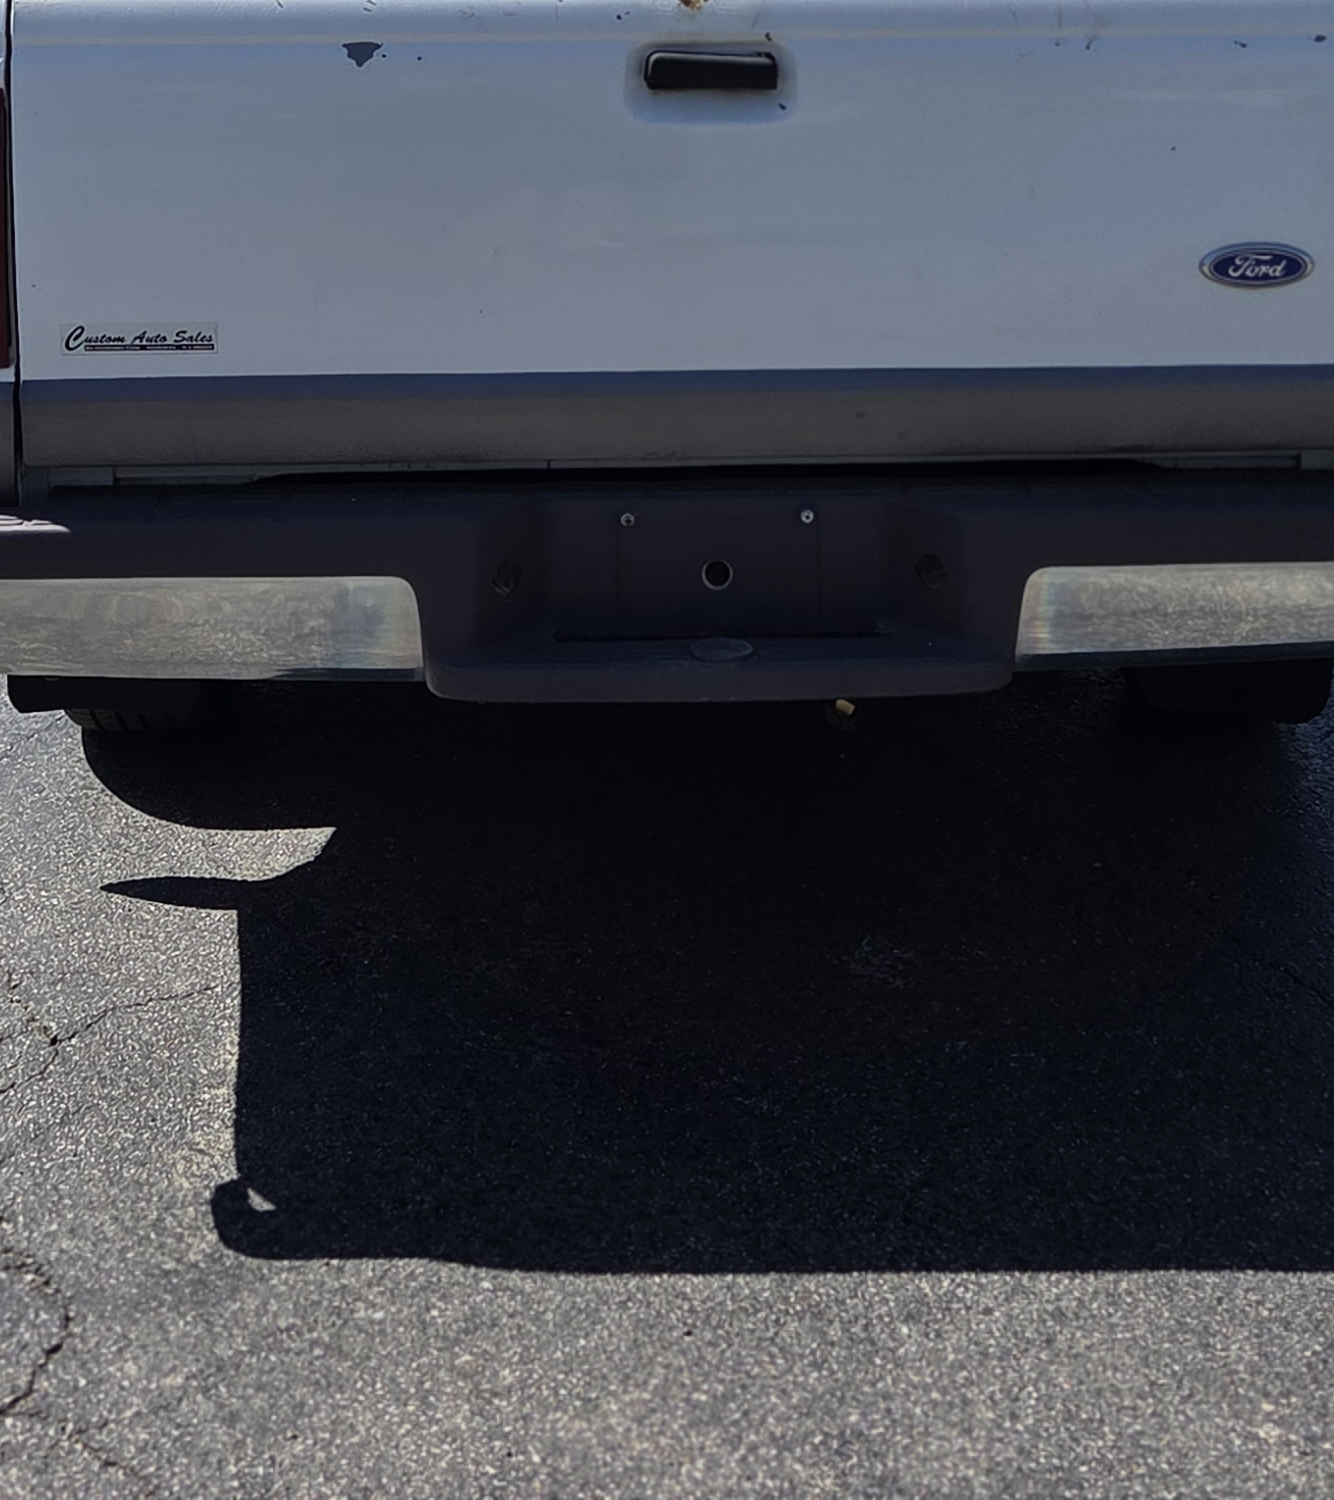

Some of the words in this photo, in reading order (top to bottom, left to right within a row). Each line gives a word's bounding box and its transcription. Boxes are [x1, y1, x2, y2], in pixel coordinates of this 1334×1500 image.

[1228, 254, 1286, 278] Ford
[64, 325, 126, 352] Custom
[130, 330, 168, 345] Auto
[173, 330, 214, 344] Sales
